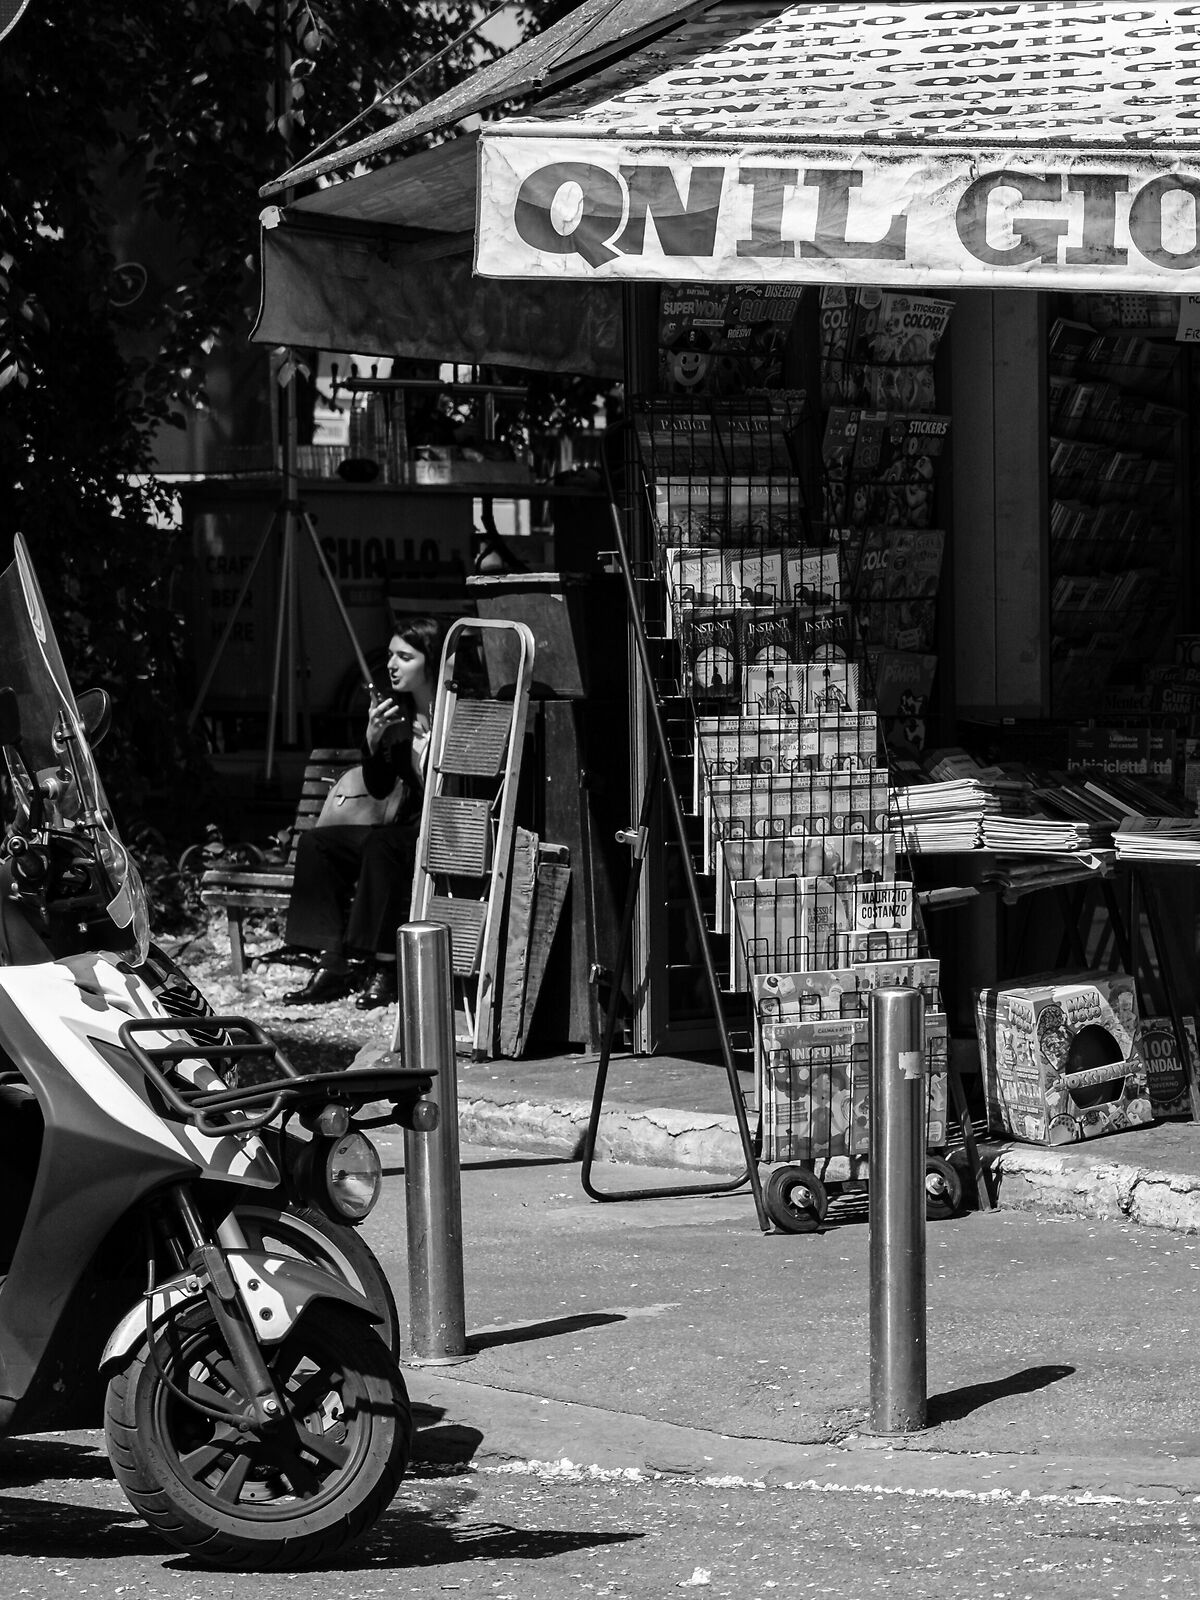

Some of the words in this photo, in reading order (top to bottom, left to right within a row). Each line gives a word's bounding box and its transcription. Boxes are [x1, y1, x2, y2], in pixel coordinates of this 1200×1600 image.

[882, 12, 1155, 40] GIORNO
[876, 47, 1156, 72] GIORNO
[611, 81, 896, 103] GIORNO
[870, 81, 1156, 105] GIORNO
[863, 114, 1156, 134] GIORNO
[660, 419, 709, 431] PARIGI
[908, 421, 949, 435] STICKERS
[861, 889, 908, 905] MAURIZIO
[861, 904, 908, 920] COSTANZO
